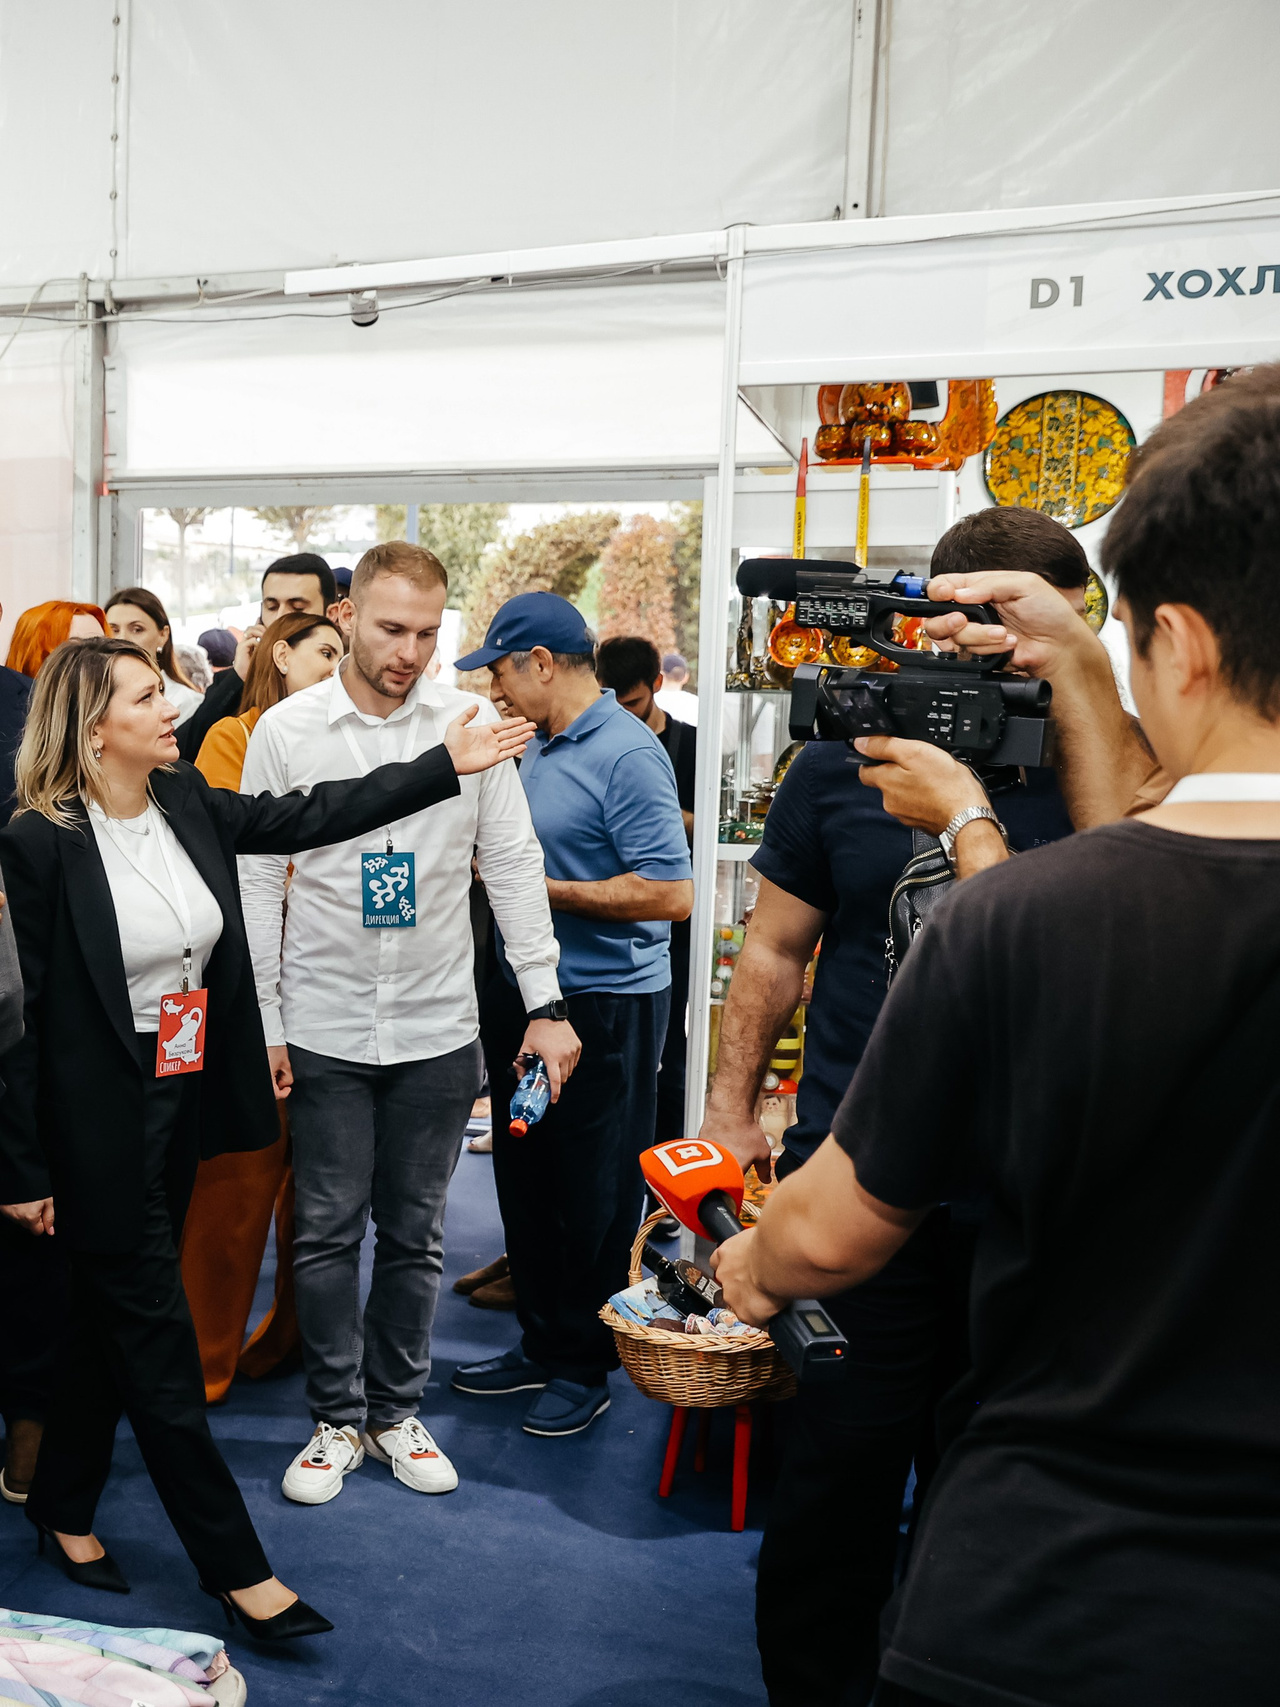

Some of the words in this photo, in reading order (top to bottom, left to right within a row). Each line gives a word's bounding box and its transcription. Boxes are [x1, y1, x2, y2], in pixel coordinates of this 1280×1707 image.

[1030, 276, 1084, 309] D1
[1142, 264, 1280, 301] ХОХЛ
[365, 914, 400, 926] ДИРЕКЦИЯ
